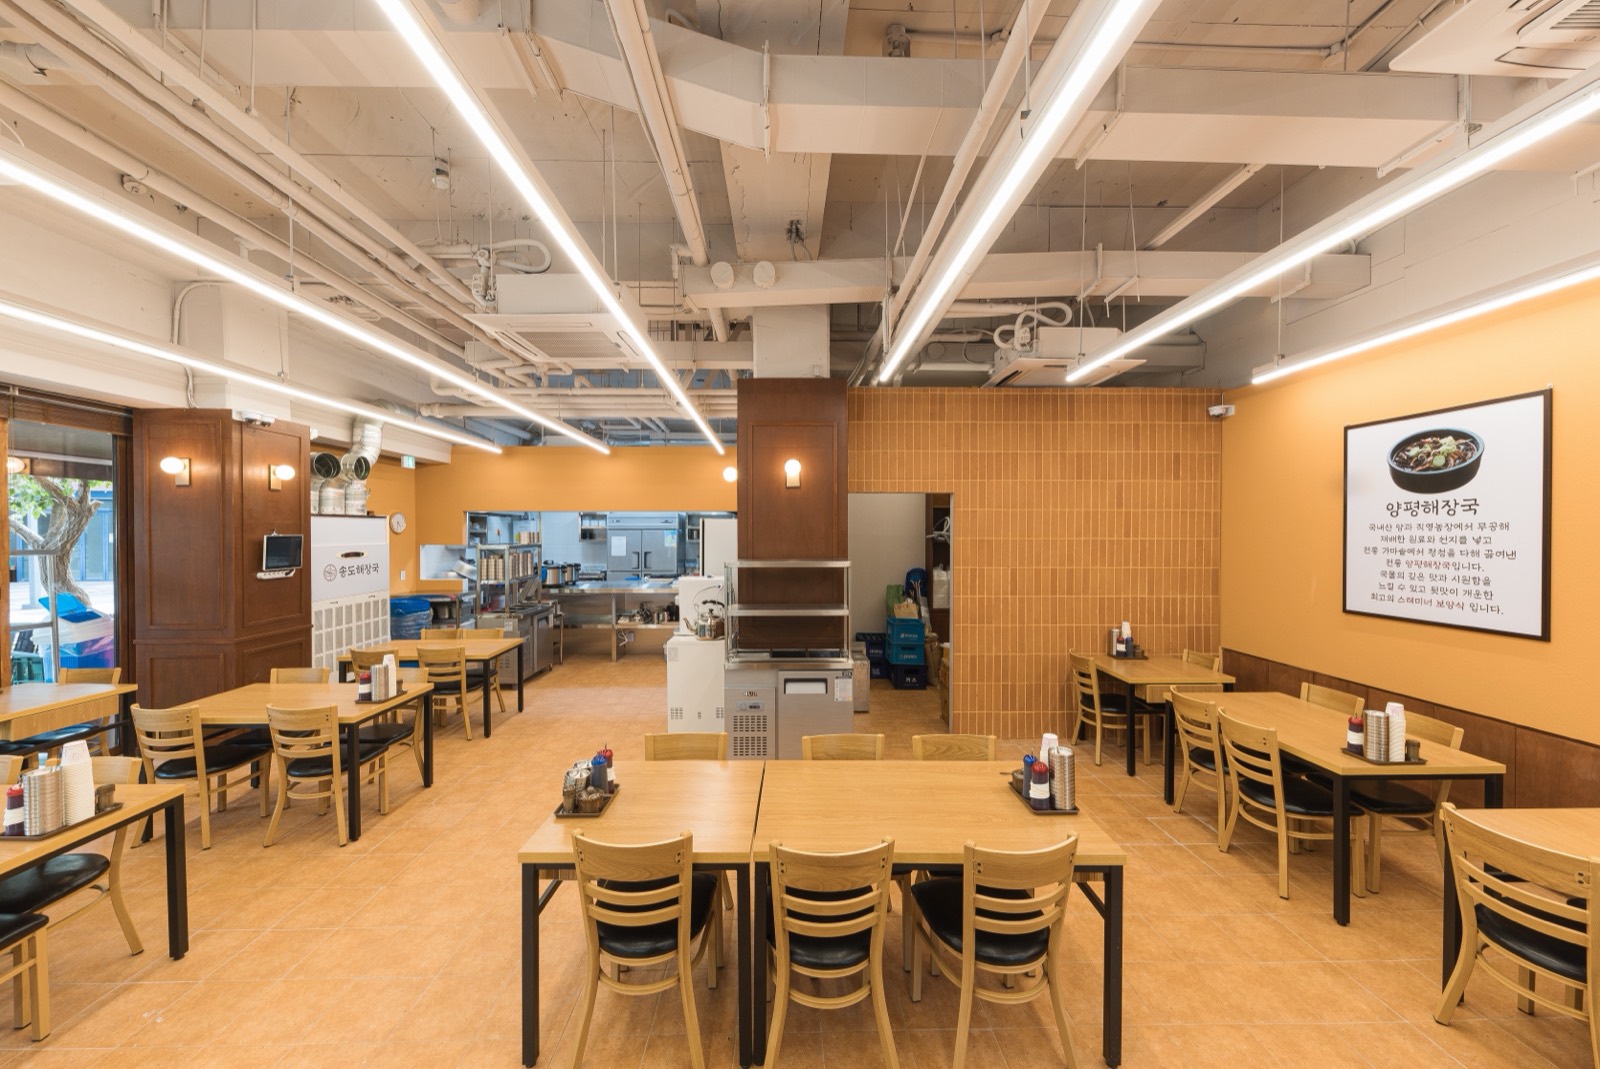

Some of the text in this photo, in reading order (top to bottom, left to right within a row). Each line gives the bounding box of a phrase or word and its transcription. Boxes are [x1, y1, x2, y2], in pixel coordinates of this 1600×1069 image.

[1386, 498, 1480, 518] 양평해장국
[1369, 523, 1392, 531] 국내산
[1460, 549, 1480, 558] 다해
[339, 563, 380, 578] 송도해장국
[1430, 573, 1447, 582] 맛과
[1410, 584, 1426, 593] 있고
[1463, 589, 1493, 600] 개운한
[1470, 603, 1504, 614] 입니다.
